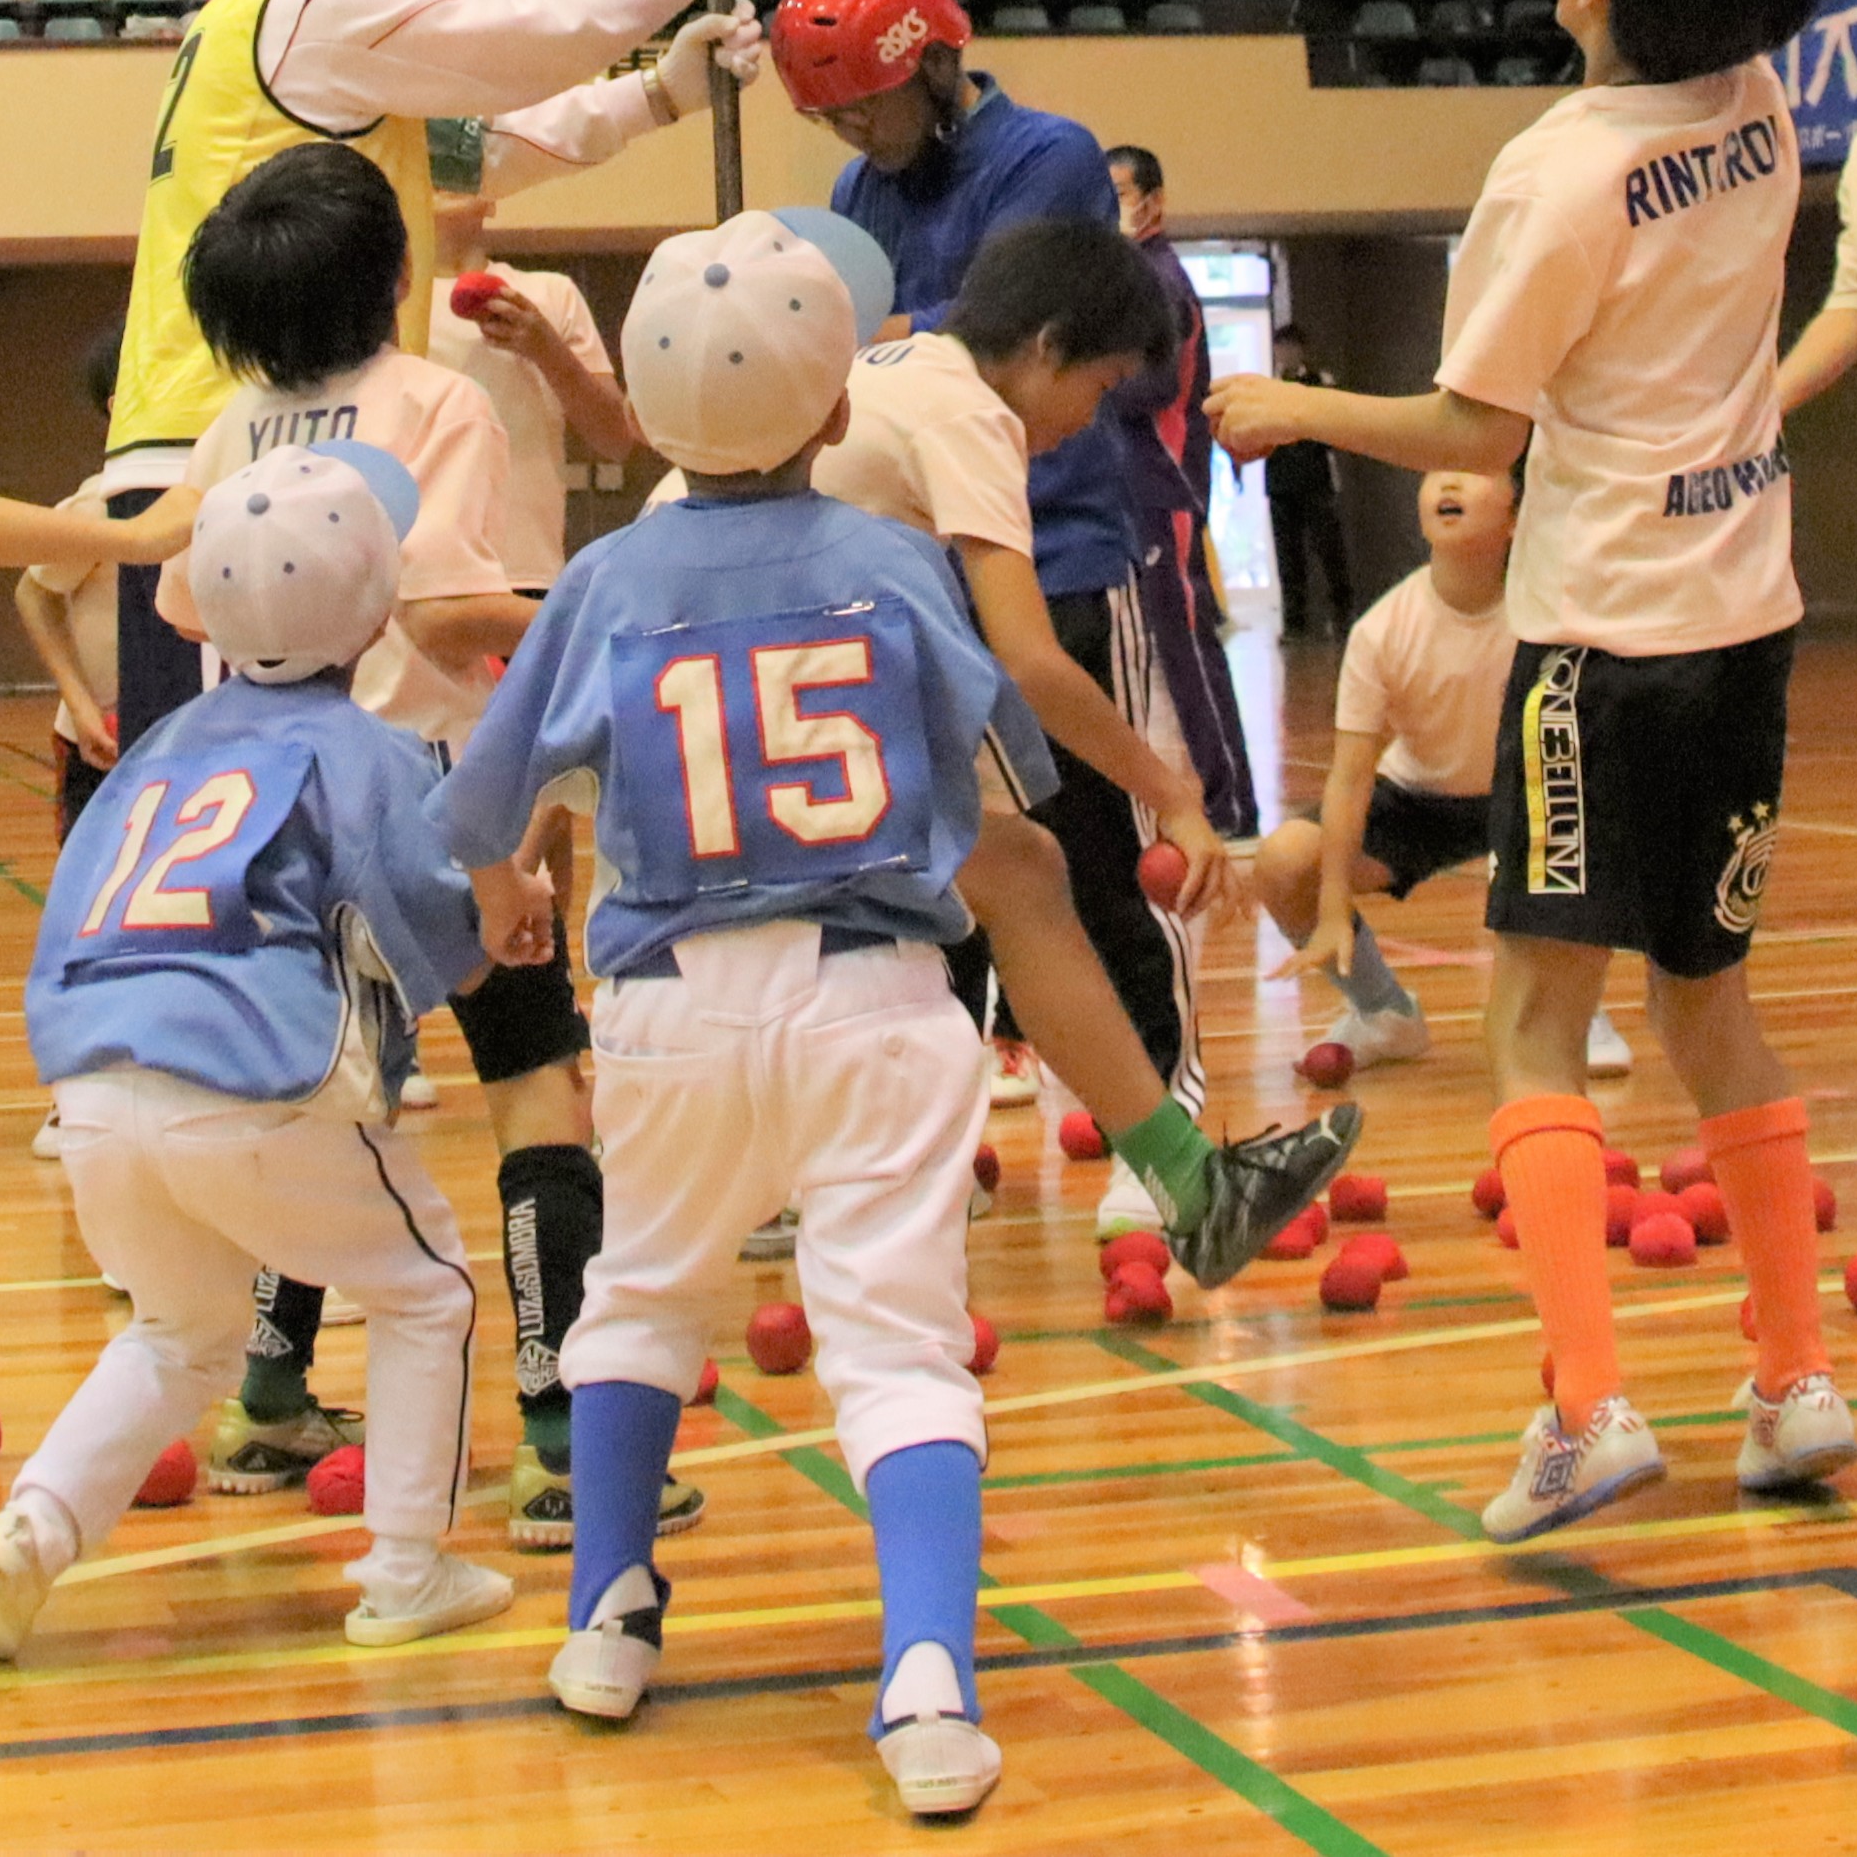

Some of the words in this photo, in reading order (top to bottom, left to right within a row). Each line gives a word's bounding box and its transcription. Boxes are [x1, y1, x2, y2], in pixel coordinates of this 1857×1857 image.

[1625, 116, 1779, 228] RINTRO
[653, 634, 893, 860] 15
[78, 767, 258, 938] 12
